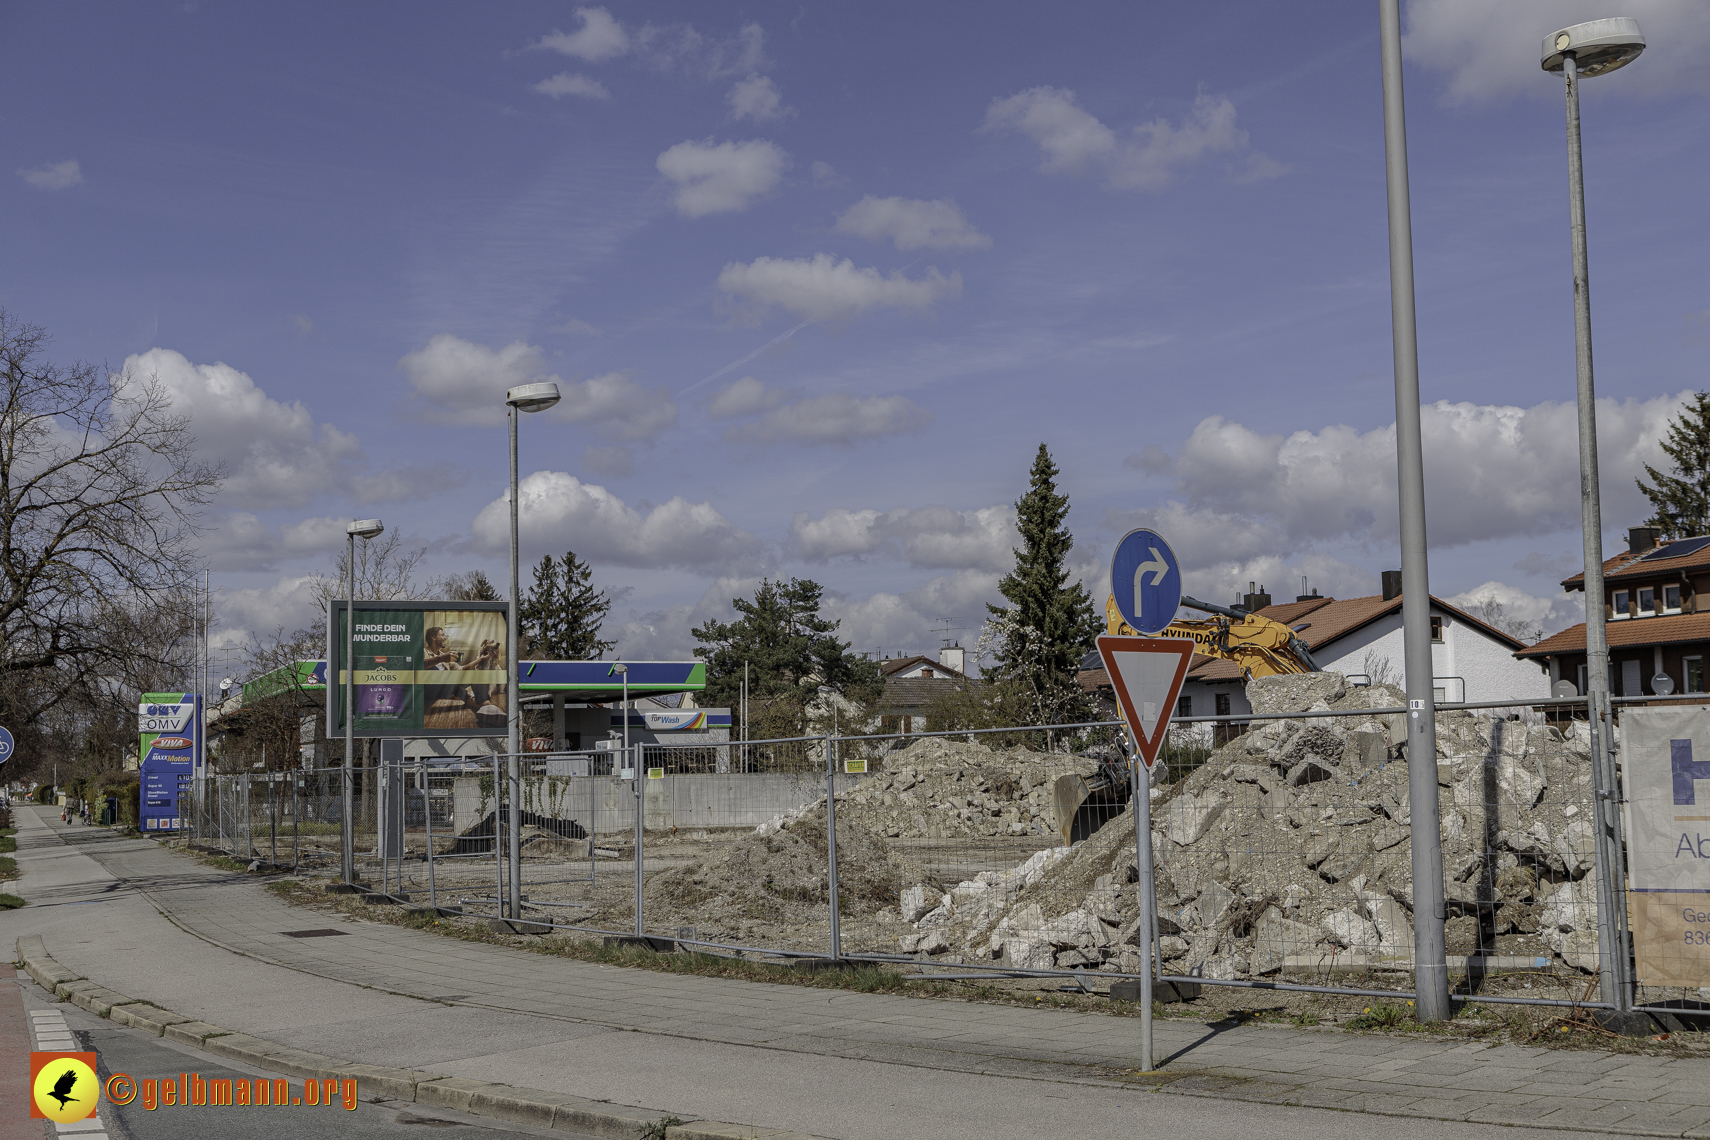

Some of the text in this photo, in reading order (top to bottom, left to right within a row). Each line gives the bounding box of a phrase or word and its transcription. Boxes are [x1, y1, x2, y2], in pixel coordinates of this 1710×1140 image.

[355, 624, 406, 632] FINDE DEIN
[353, 634, 411, 642] WUNDERBAR
[365, 674, 397, 682] JACOBS
[661, 716, 680, 724] Wash
[147, 719, 181, 730] OMV
[160, 739, 184, 748] VIVA
